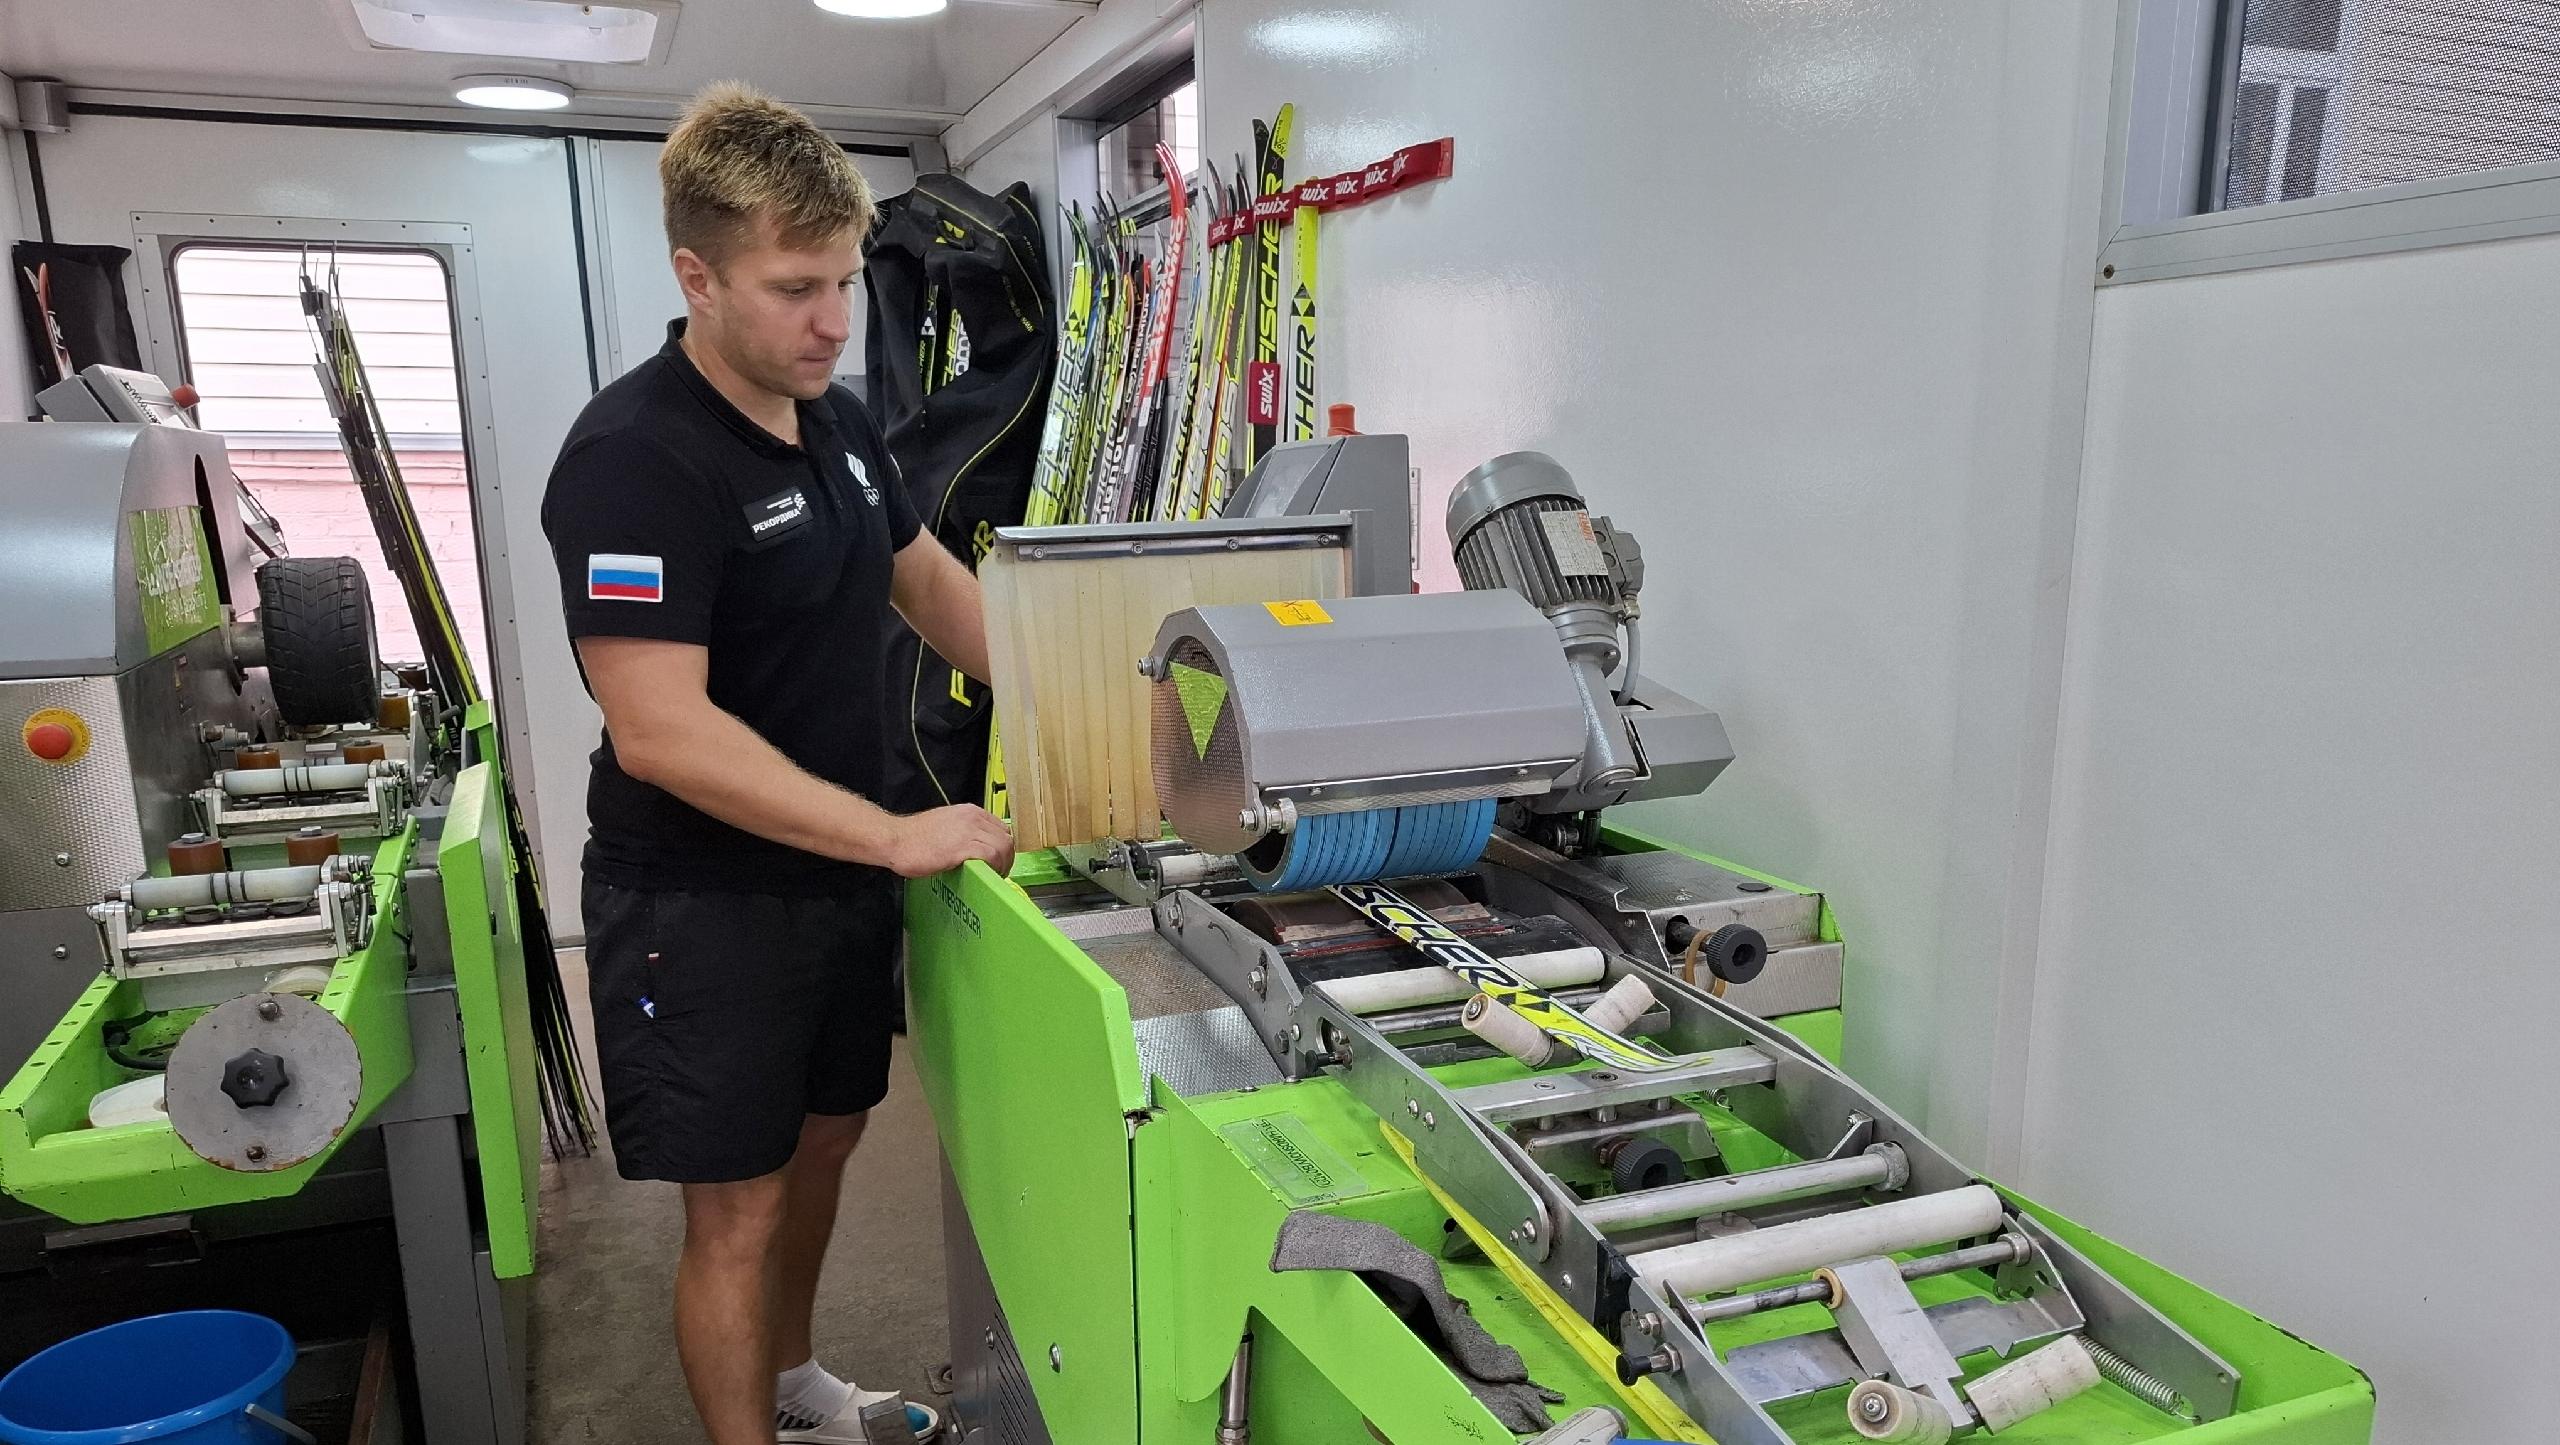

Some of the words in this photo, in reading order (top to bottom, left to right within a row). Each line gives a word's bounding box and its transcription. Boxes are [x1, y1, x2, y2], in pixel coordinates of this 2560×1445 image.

[1254, 197, 1289, 216] swix
[1260, 367, 1274, 419] swix
[752, 509, 802, 534] РЕКОРДИКА
